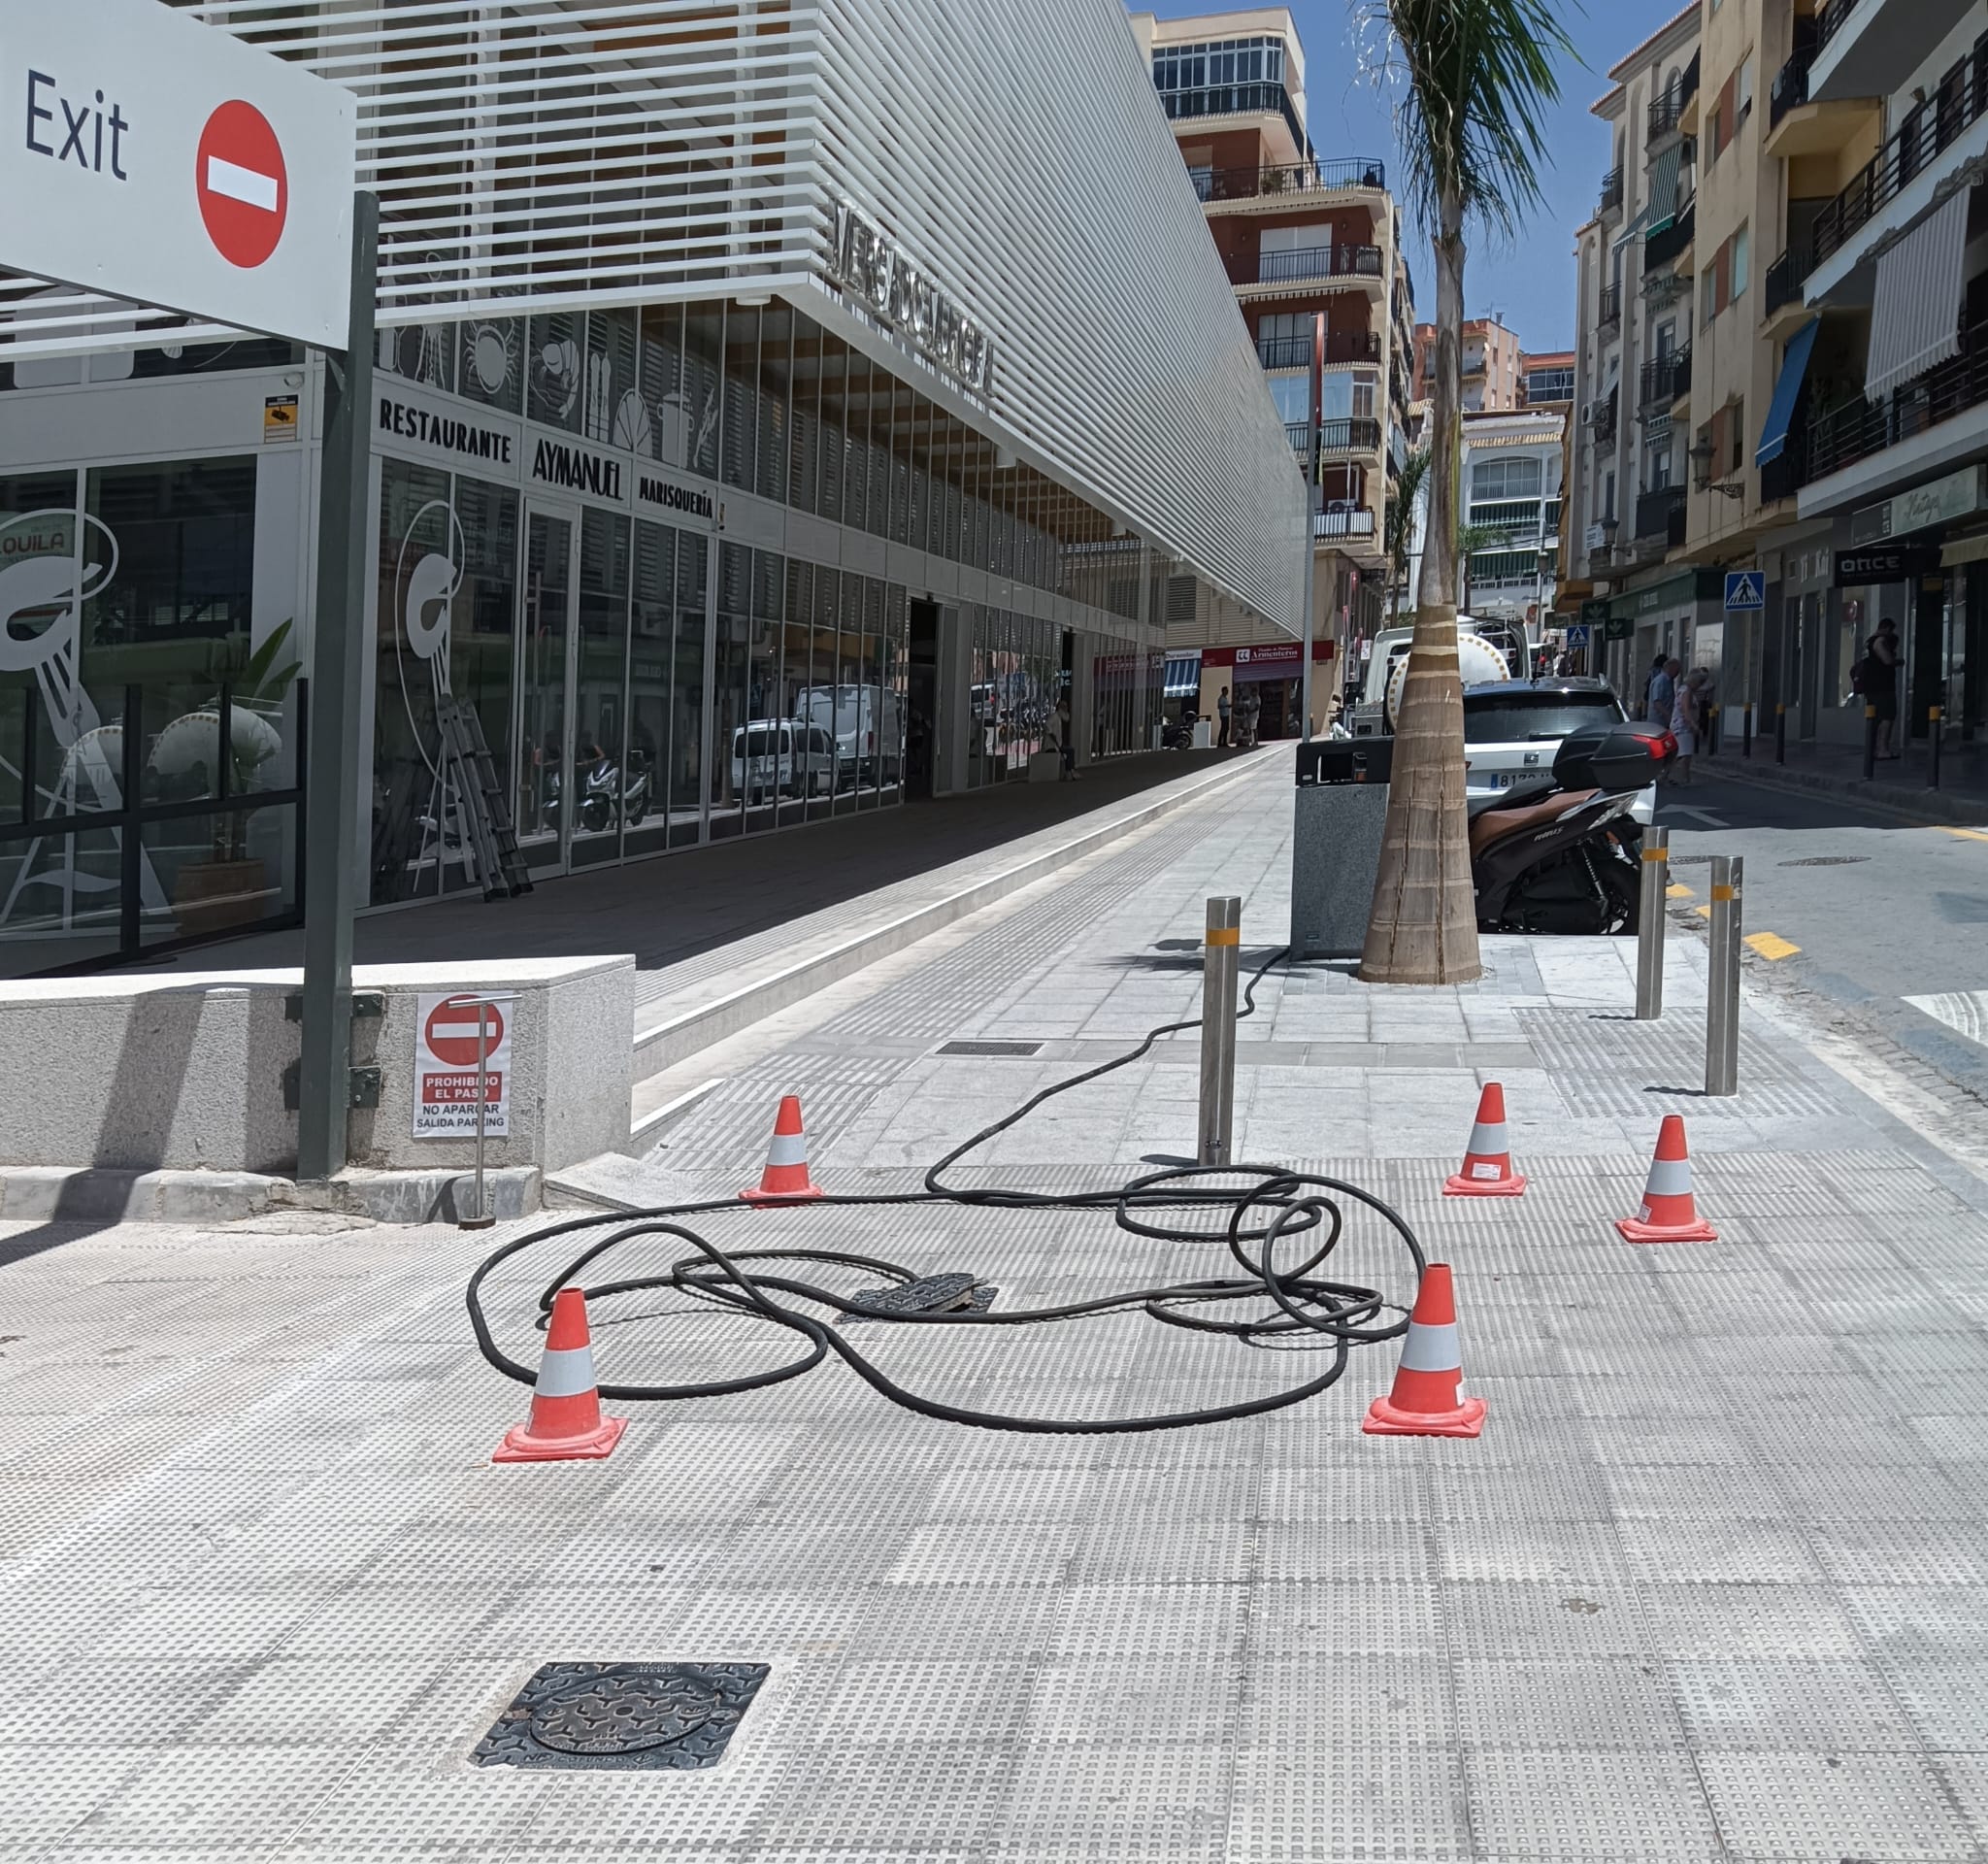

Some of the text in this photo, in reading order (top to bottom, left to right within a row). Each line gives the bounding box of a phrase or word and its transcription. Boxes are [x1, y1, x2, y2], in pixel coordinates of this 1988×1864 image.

[26, 69, 128, 182] Exit
[380, 398, 713, 519] RESTAURANTE AYMANUEL MARISQUERÍA
[0, 532, 65, 555] QUILA
[435, 1088, 450, 1099] EL
[422, 1105, 440, 1115] NO
[416, 1117, 505, 1128] SALIDA PARING
